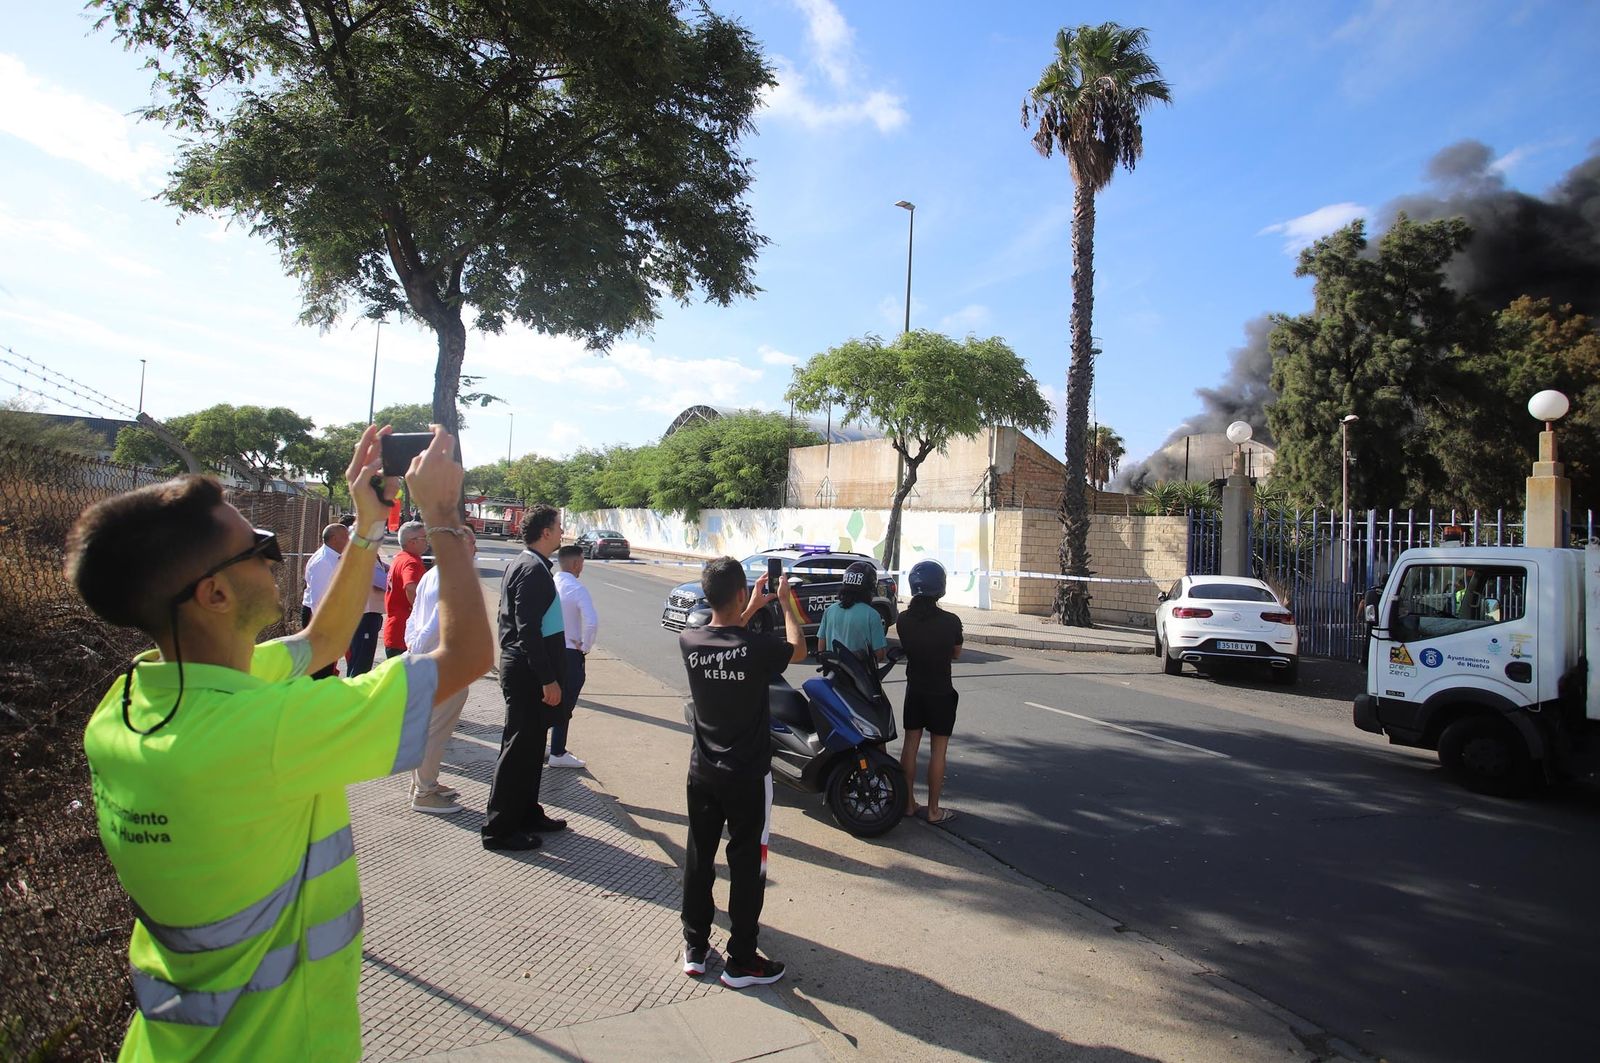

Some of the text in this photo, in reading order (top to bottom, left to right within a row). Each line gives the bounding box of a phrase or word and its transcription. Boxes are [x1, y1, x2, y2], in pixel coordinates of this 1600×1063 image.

[1222, 641, 1254, 651] 3518 LVY
[688, 646, 747, 669] Burgers
[1447, 654, 1490, 664] Ayuntamiento
[1467, 662, 1490, 670] Huelva
[704, 669, 746, 681] KEBAB
[118, 825, 172, 844] Huelva
